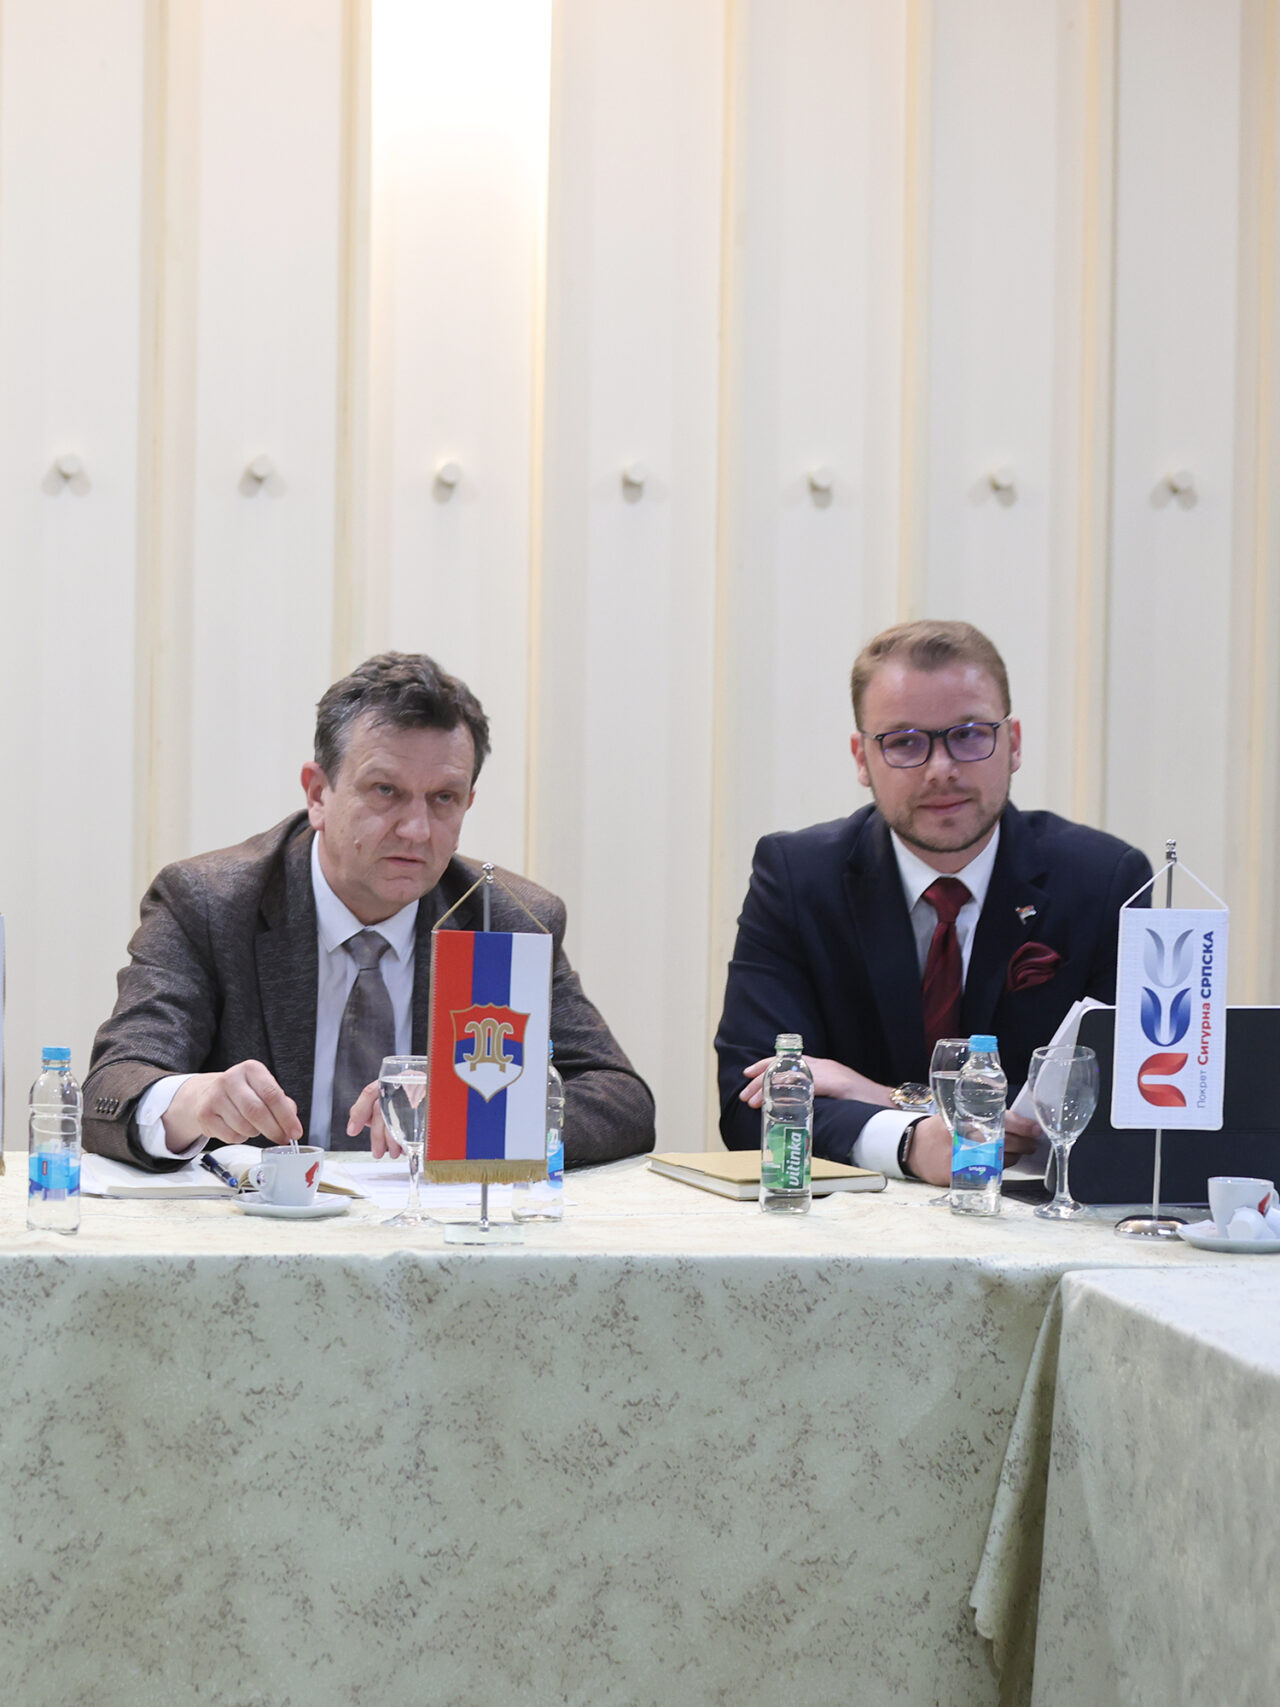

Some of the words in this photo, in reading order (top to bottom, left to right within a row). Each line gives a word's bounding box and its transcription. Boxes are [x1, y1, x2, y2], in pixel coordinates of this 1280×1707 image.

[1200, 931, 1214, 999] СРПСКА
[1197, 1003, 1212, 1065] Сигурна
[1197, 1070, 1208, 1108] Покрет
[786, 1132, 802, 1186] vitinka
